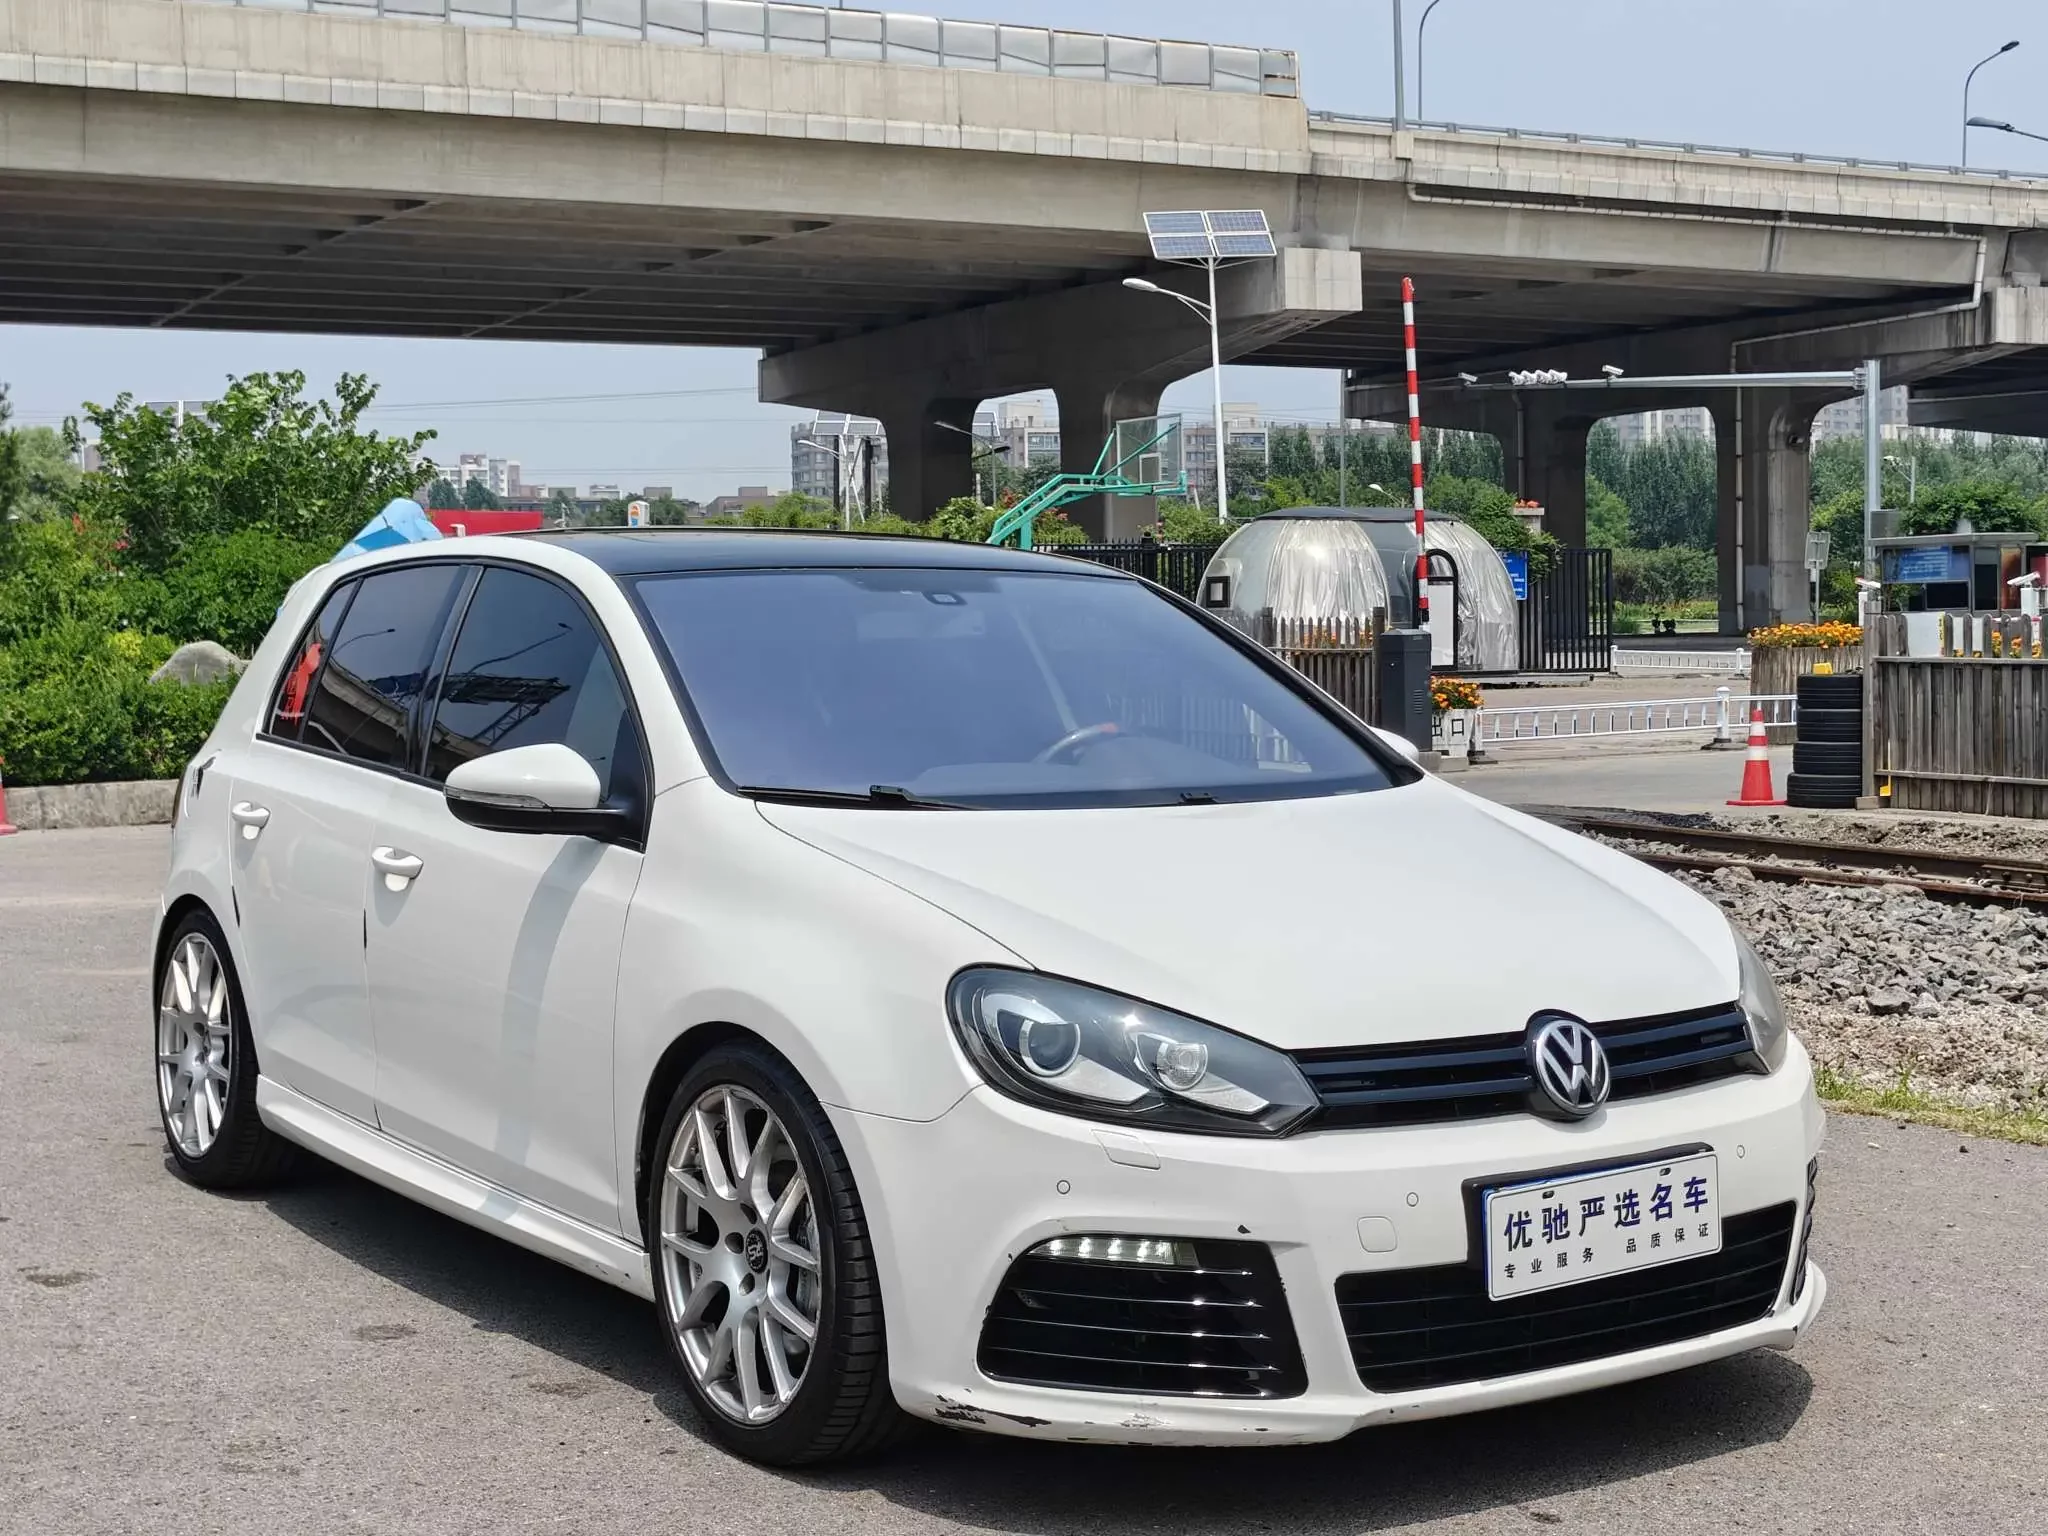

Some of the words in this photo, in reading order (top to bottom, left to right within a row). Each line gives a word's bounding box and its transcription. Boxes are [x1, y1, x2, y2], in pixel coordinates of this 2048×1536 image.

[1503, 1176, 1709, 1252] 优驰严选名车
[1503, 1247, 1594, 1279] 专业服务
[1625, 1222, 1710, 1254] 品质保证
